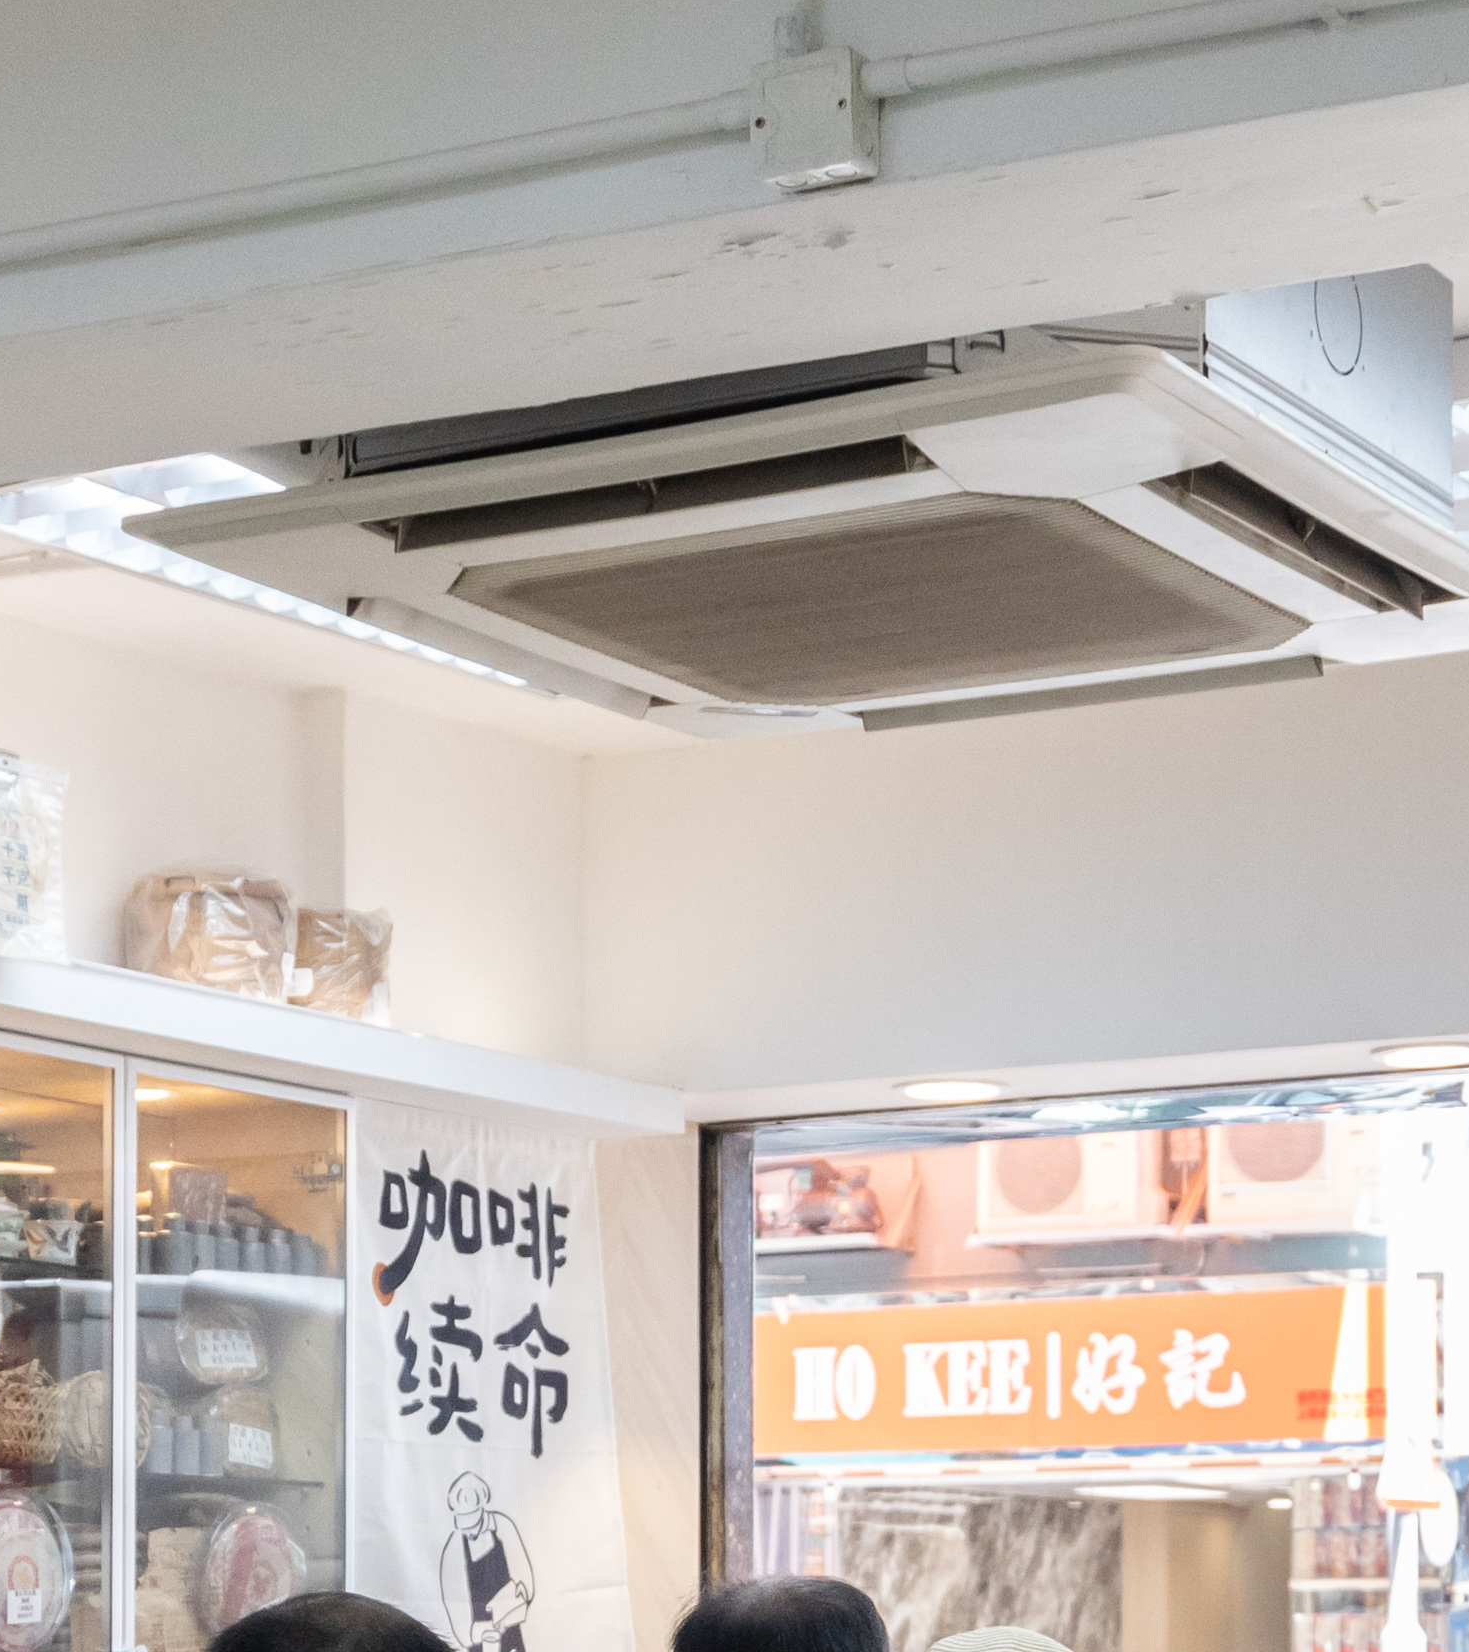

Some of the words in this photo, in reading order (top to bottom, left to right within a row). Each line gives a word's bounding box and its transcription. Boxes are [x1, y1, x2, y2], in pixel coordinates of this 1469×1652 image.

[377, 1148, 571, 1294] 咖啡
[394, 1294, 571, 1459] 续命
[792, 1344, 877, 1421] HO
[902, 1338, 1033, 1417] KEE
[1071, 1328, 1247, 1415] 好記
